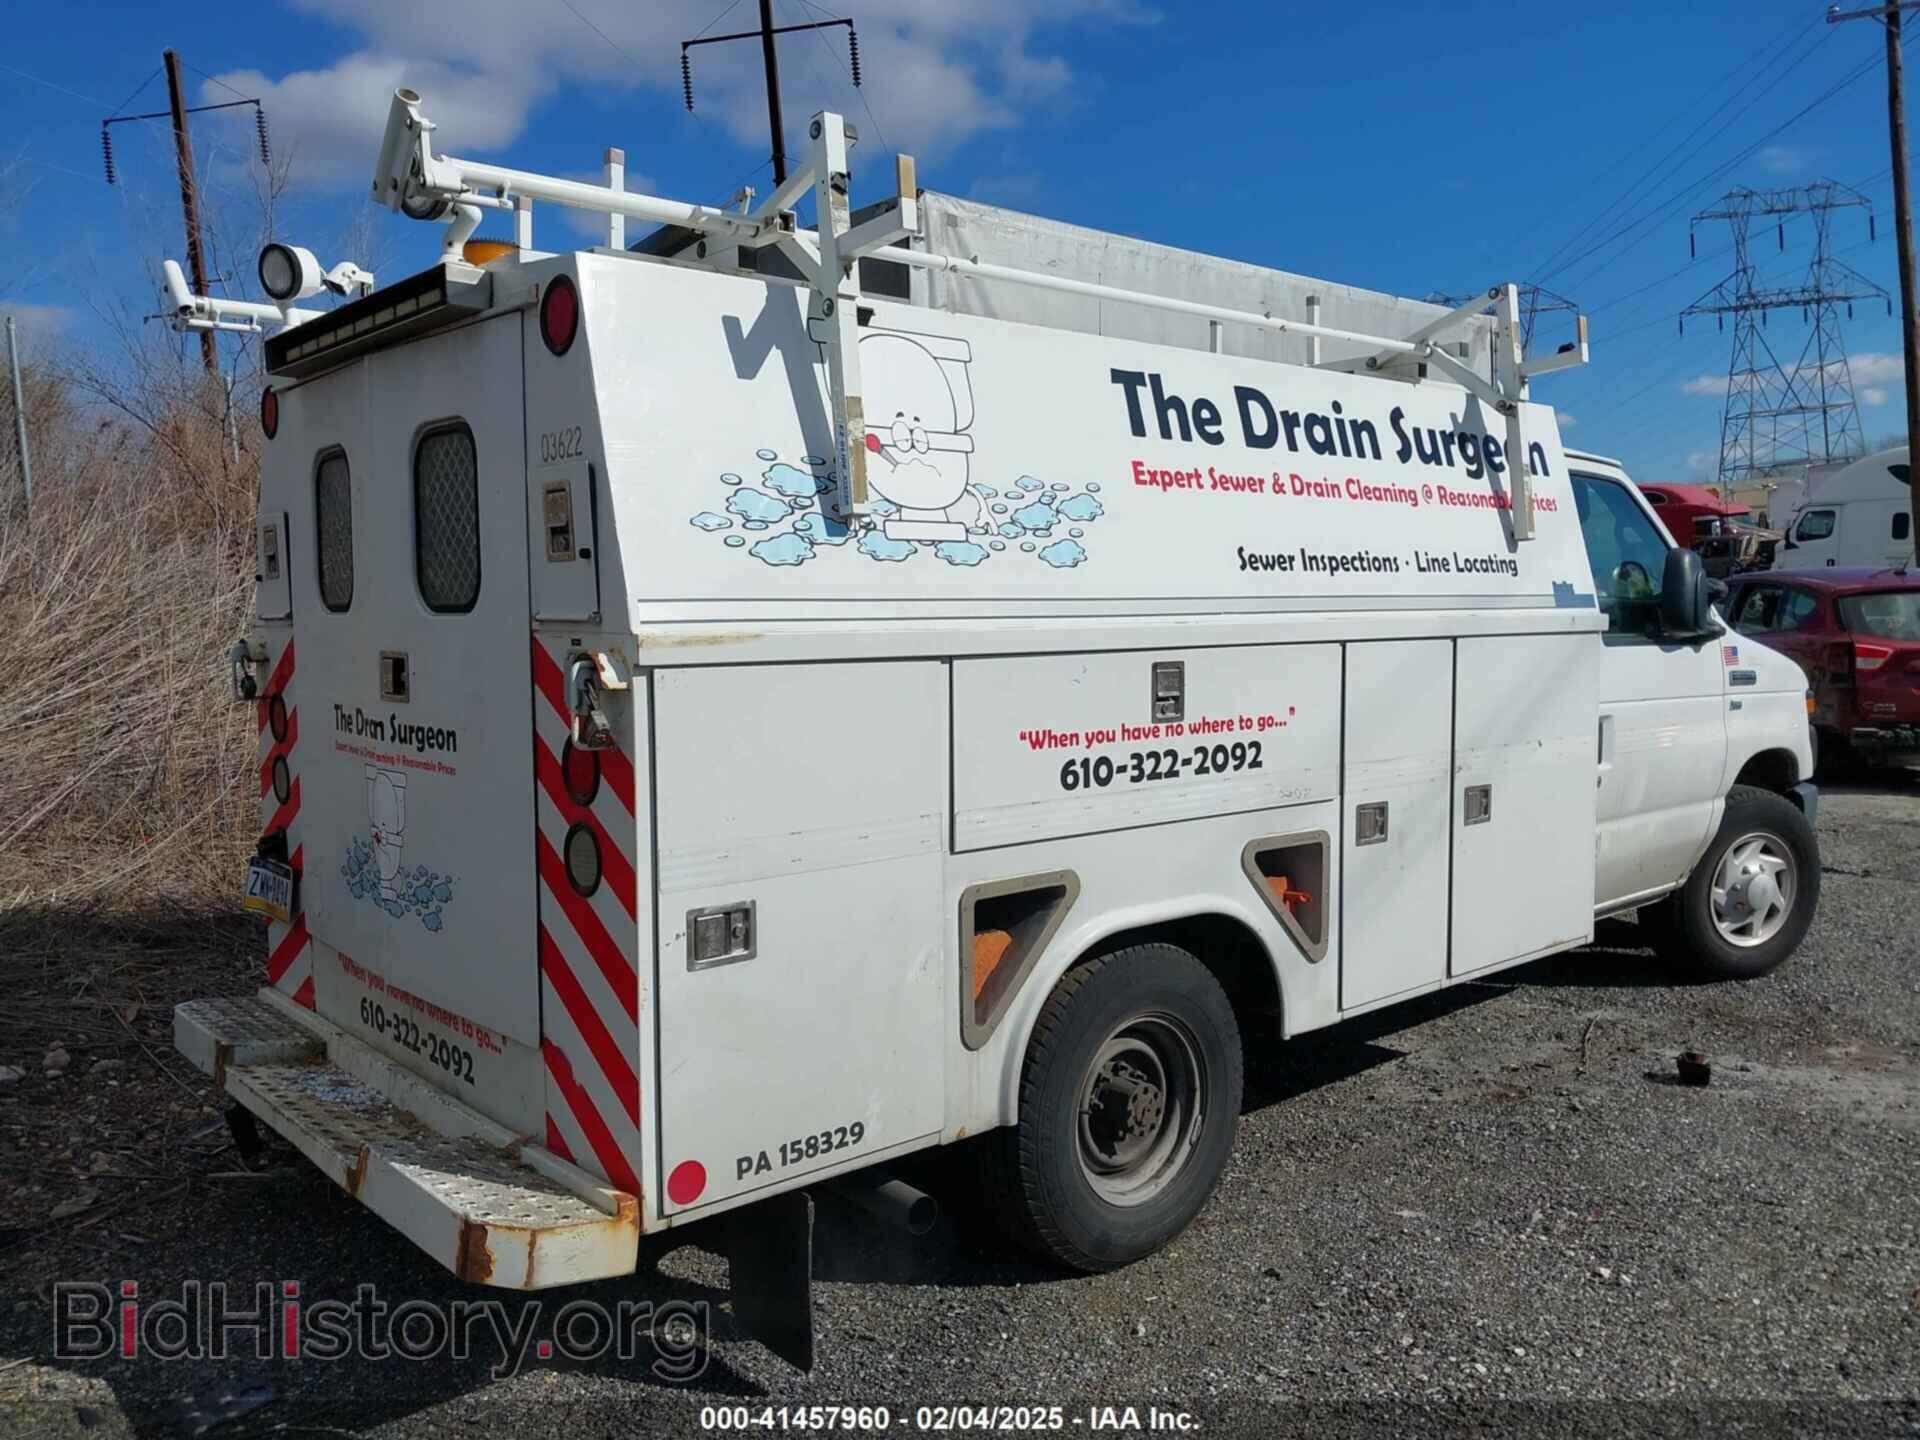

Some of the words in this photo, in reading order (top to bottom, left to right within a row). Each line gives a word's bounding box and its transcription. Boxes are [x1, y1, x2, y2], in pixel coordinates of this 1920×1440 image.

[541, 425, 583, 462] 03622
[1110, 368, 1225, 446] The
[1233, 385, 1382, 460] Drain
[1389, 406, 1551, 480] Surgen
[1131, 460, 1205, 493] Expert
[1207, 466, 1266, 494] Sewer
[1272, 472, 1287, 495] &
[1289, 473, 1342, 499] Drain
[1345, 478, 1418, 507] Cleaning
[1421, 484, 1434, 506] @
[1533, 491, 1558, 512] ices
[1237, 546, 1296, 572] Sewer
[1300, 547, 1400, 577] Inspections
[1414, 550, 1451, 573] Line
[1453, 551, 1519, 578] Locating
[334, 704, 353, 735] The
[389, 712, 457, 752] Surgeon
[1085, 729, 1117, 751] you
[1120, 723, 1161, 743] have
[1165, 721, 1185, 738] no
[1188, 716, 1235, 735] where
[1238, 713, 1254, 731] to
[1060, 740, 1264, 792] 610-322-2092
[360, 996, 476, 1086] 610-322-2092
[461, 1015, 473, 1038] to
[736, 1150, 772, 1181] PA
[779, 1120, 865, 1167] 158329
